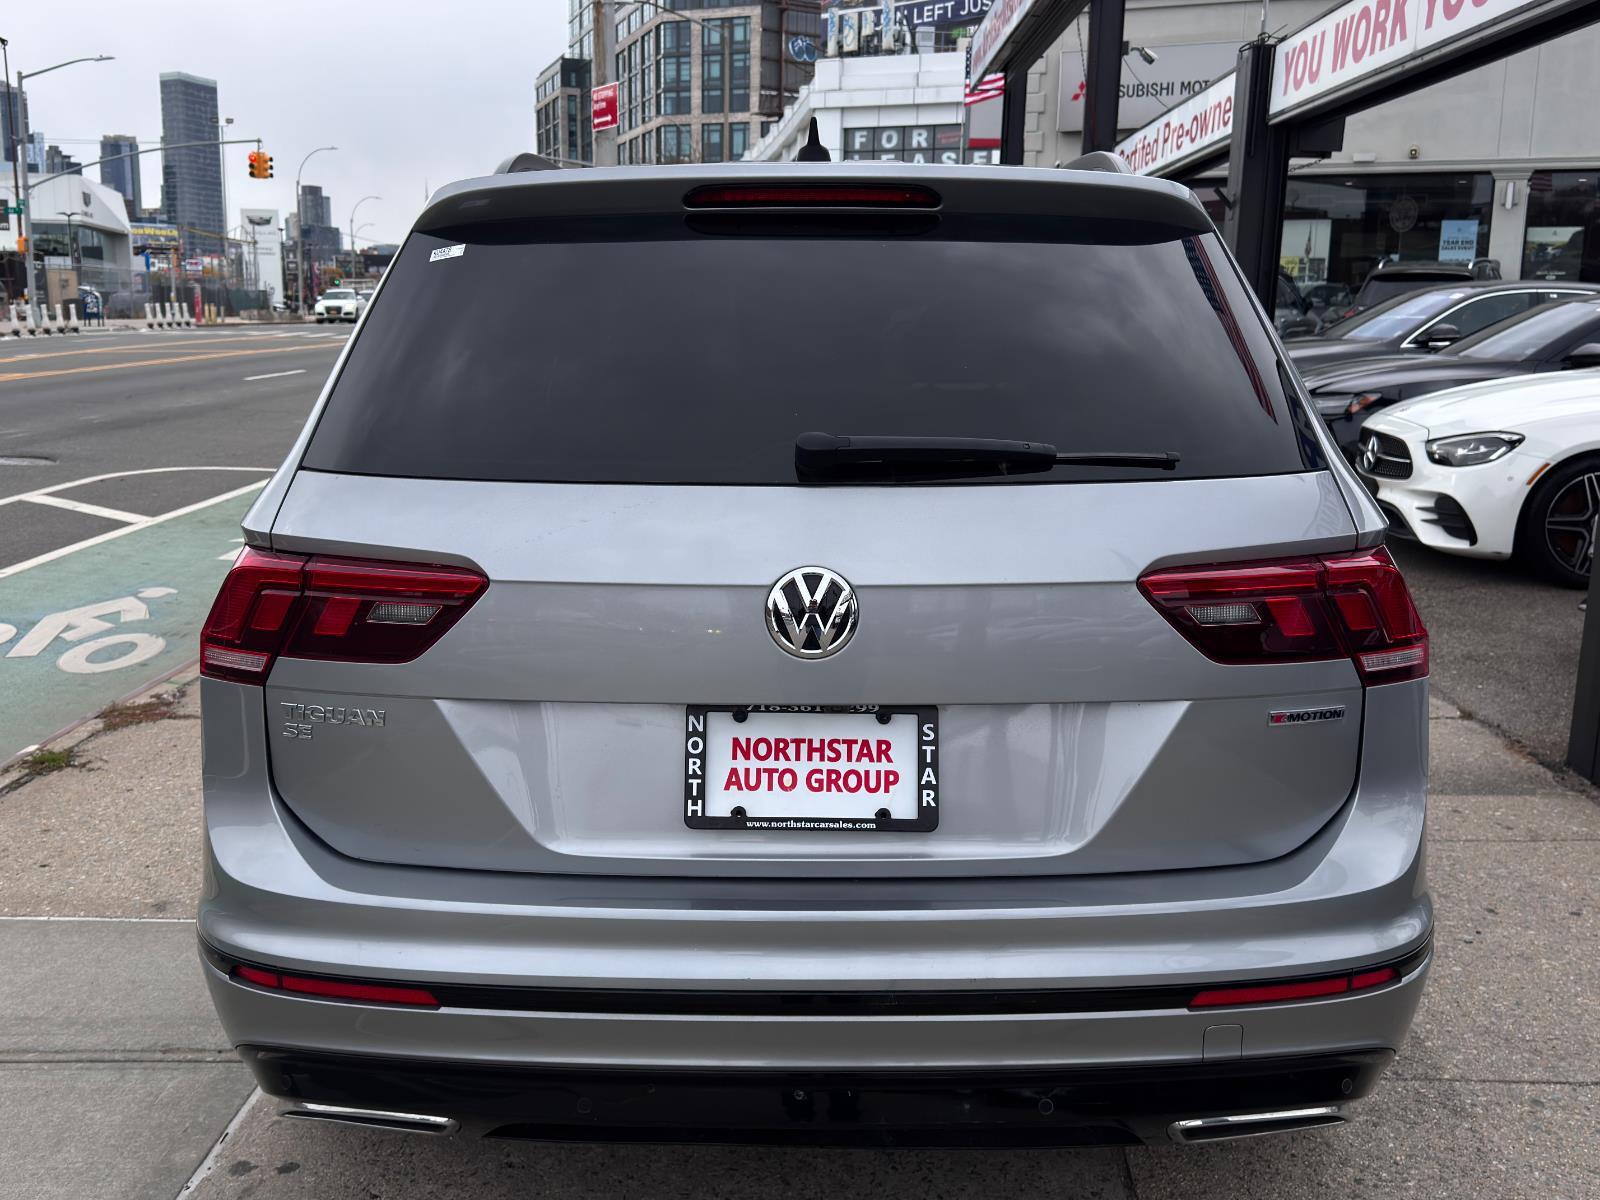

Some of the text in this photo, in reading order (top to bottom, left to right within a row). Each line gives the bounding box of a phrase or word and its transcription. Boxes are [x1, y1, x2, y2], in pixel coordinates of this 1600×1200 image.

[913, 2, 955, 24] LEFT
[1283, 30, 1326, 96] YOU
[1332, 0, 1407, 73] WORK
[854, 129, 928, 149] FOR
[281, 702, 386, 727] TIGUAN
[1270, 708, 1345, 724] MOTION
[282, 722, 313, 740] SE
[731, 737, 893, 763] NORTHSTAR
[687, 715, 704, 817] NORTH
[920, 723, 937, 807] STAR
[724, 768, 900, 794] AUTO GROUP
[746, 820, 876, 829] www.northstarcarsales.com
